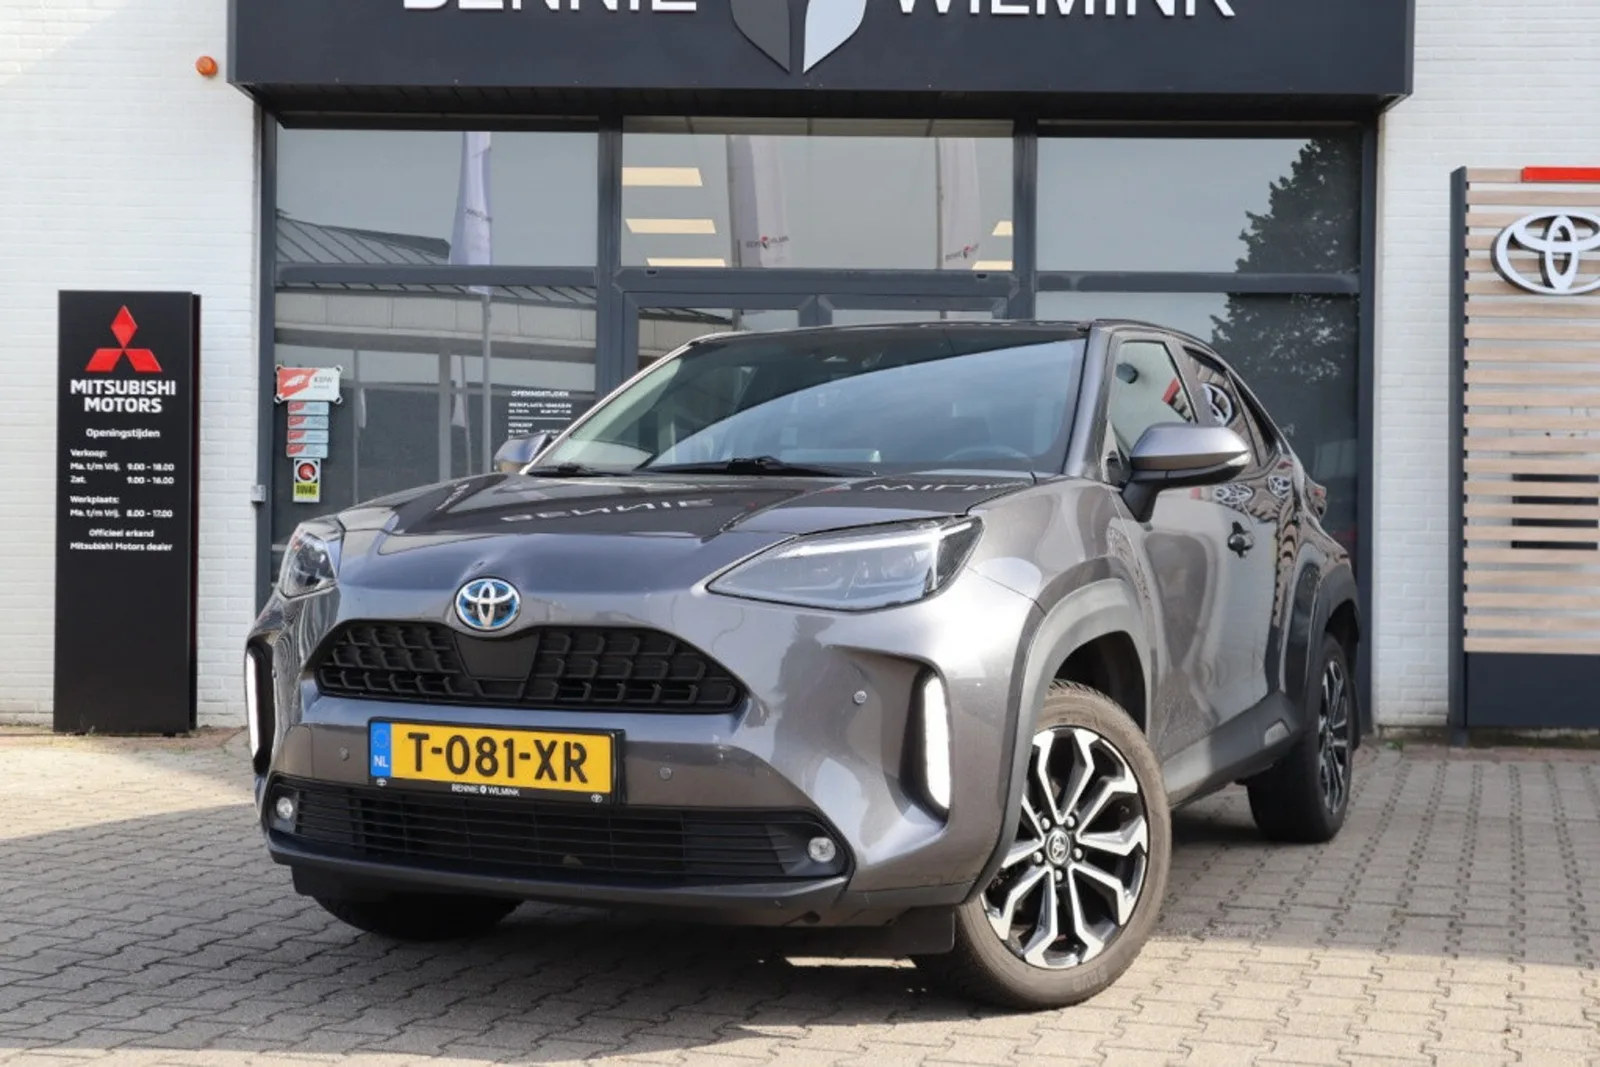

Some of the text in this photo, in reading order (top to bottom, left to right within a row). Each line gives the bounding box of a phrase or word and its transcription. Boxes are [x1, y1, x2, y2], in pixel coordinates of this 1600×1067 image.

[70, 380, 177, 395] MITSUBISHI
[84, 397, 162, 413] MOTORS
[85, 428, 160, 439] Openingstijden
[86, 462, 104, 471] t/m
[70, 495, 120, 505] Werkplaats:
[86, 508, 104, 518] t/m
[88, 529, 155, 538] Officieel erkend
[70, 542, 173, 551] Mitsubishi Motors dealer
[373, 755, 390, 769] NL
[407, 731, 588, 784] T-081-XR
